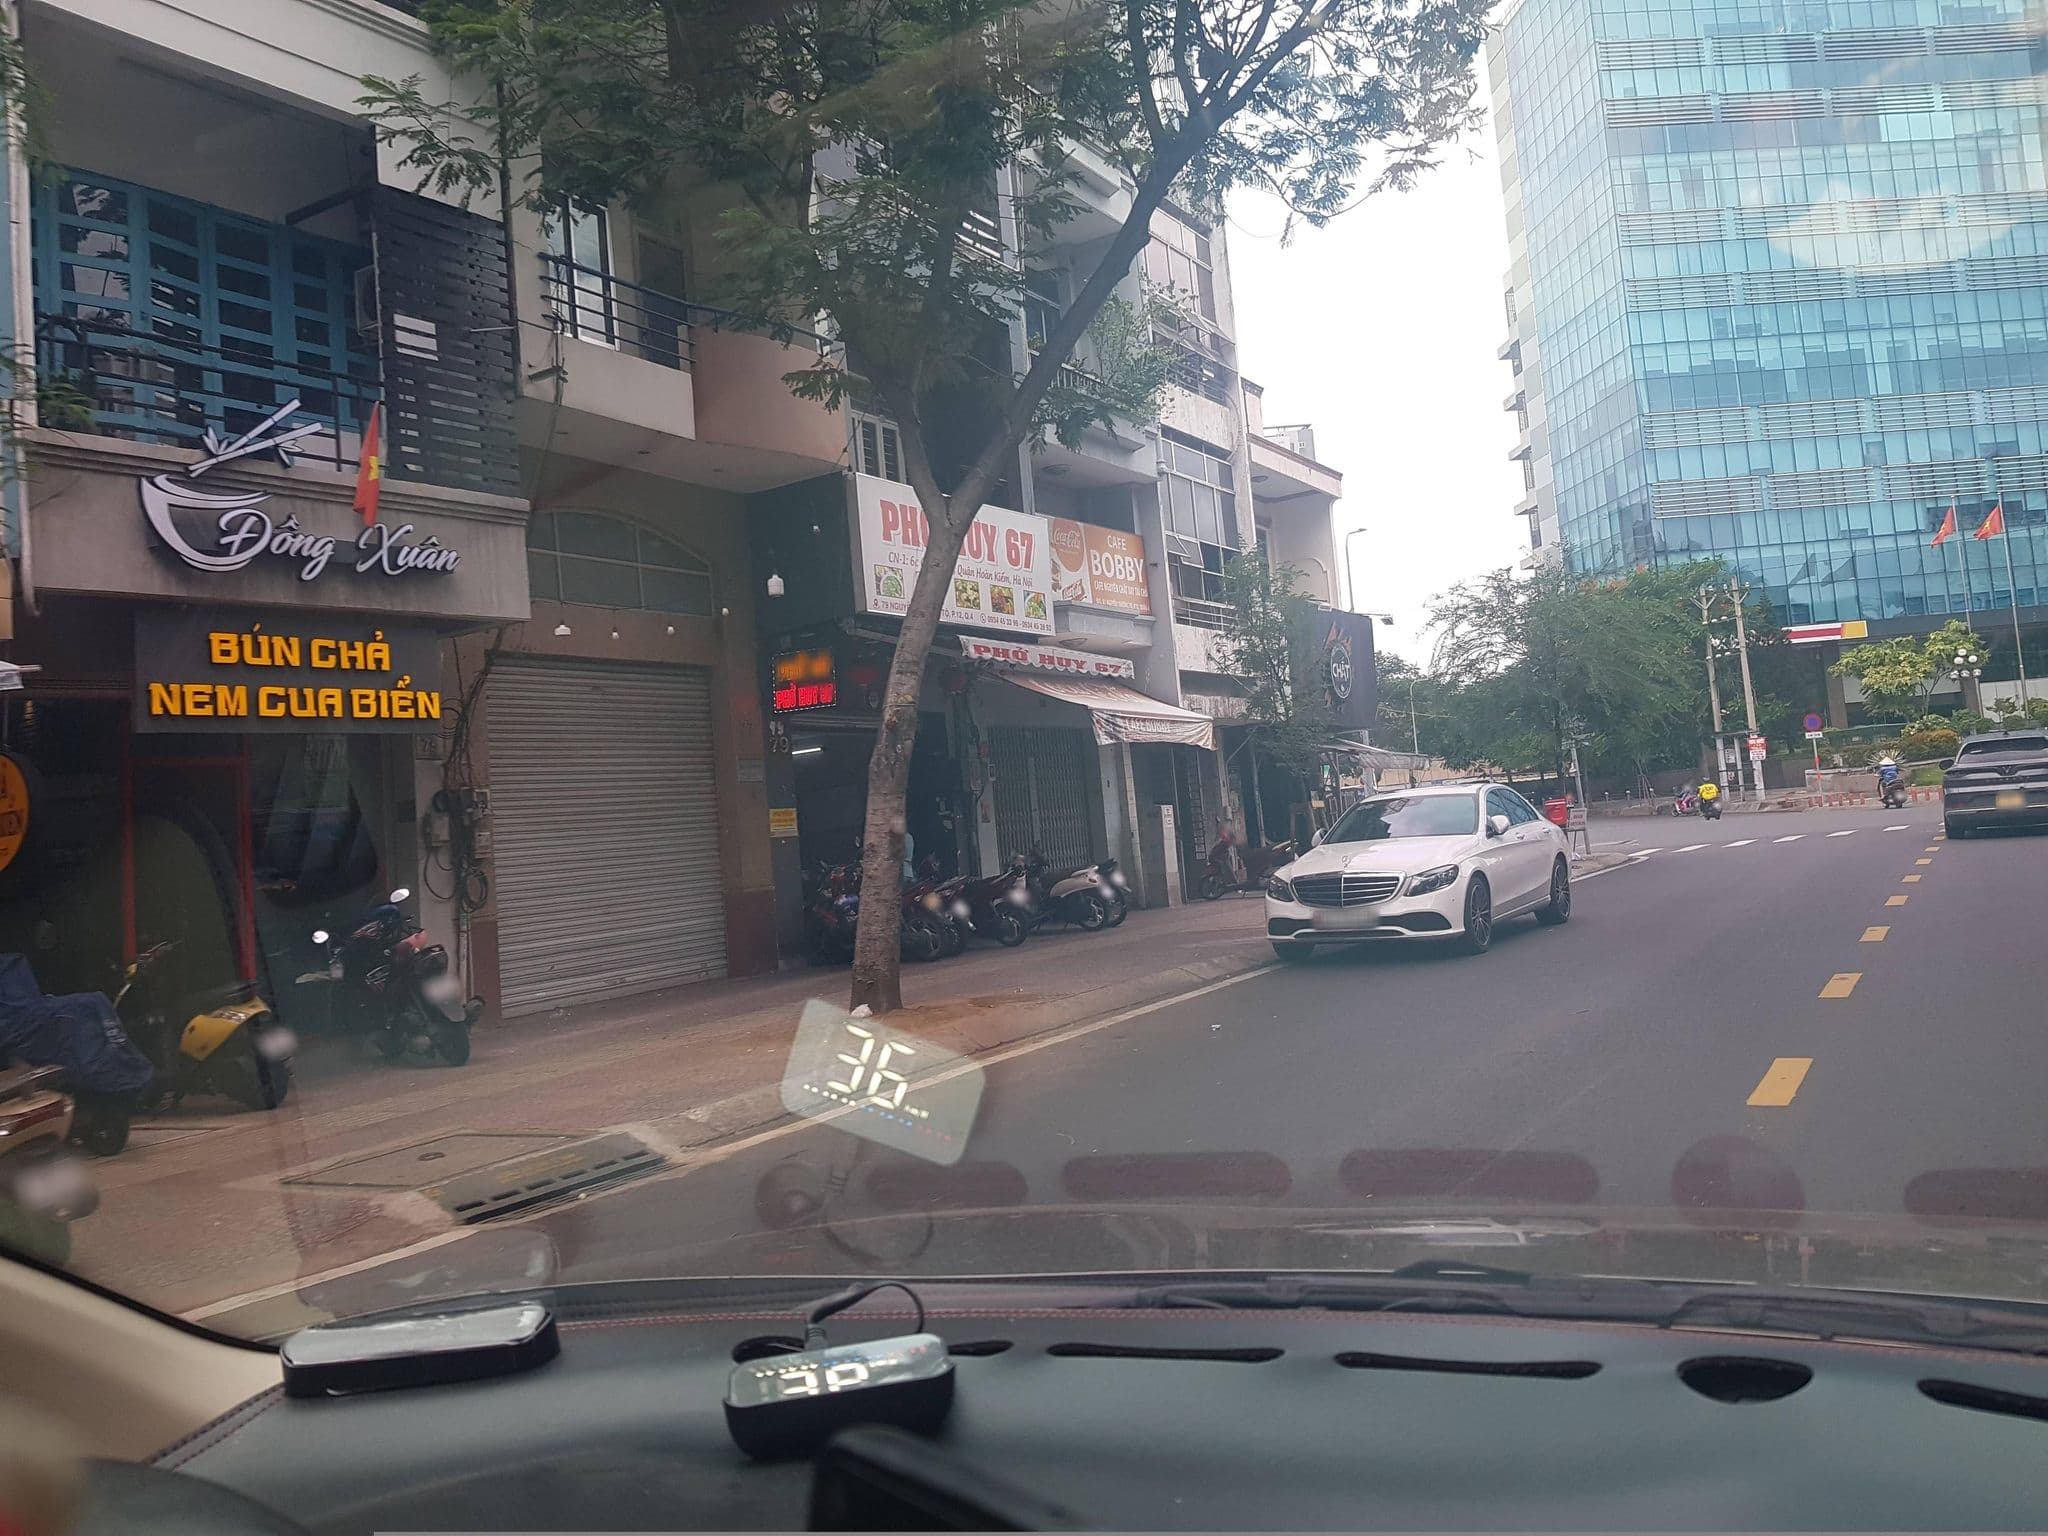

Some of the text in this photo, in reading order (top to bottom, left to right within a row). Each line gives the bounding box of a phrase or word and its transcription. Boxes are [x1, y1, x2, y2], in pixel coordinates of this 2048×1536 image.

[356, 523, 460, 576] Xuân
[959, 520, 997, 562] UY
[1005, 528, 1033, 569] 67
[1107, 535, 1127, 550] CAFE
[976, 567, 993, 580] Hoàn
[1012, 574, 1021, 586] Hà
[1090, 549, 1145, 583] BOBBY
[208, 623, 391, 672] BÚN CHẢ
[973, 644, 1122, 674] PHỞ HUY 67
[148, 676, 442, 720] NEM CUA BIỂN
[827, 1022, 916, 1110] 36
